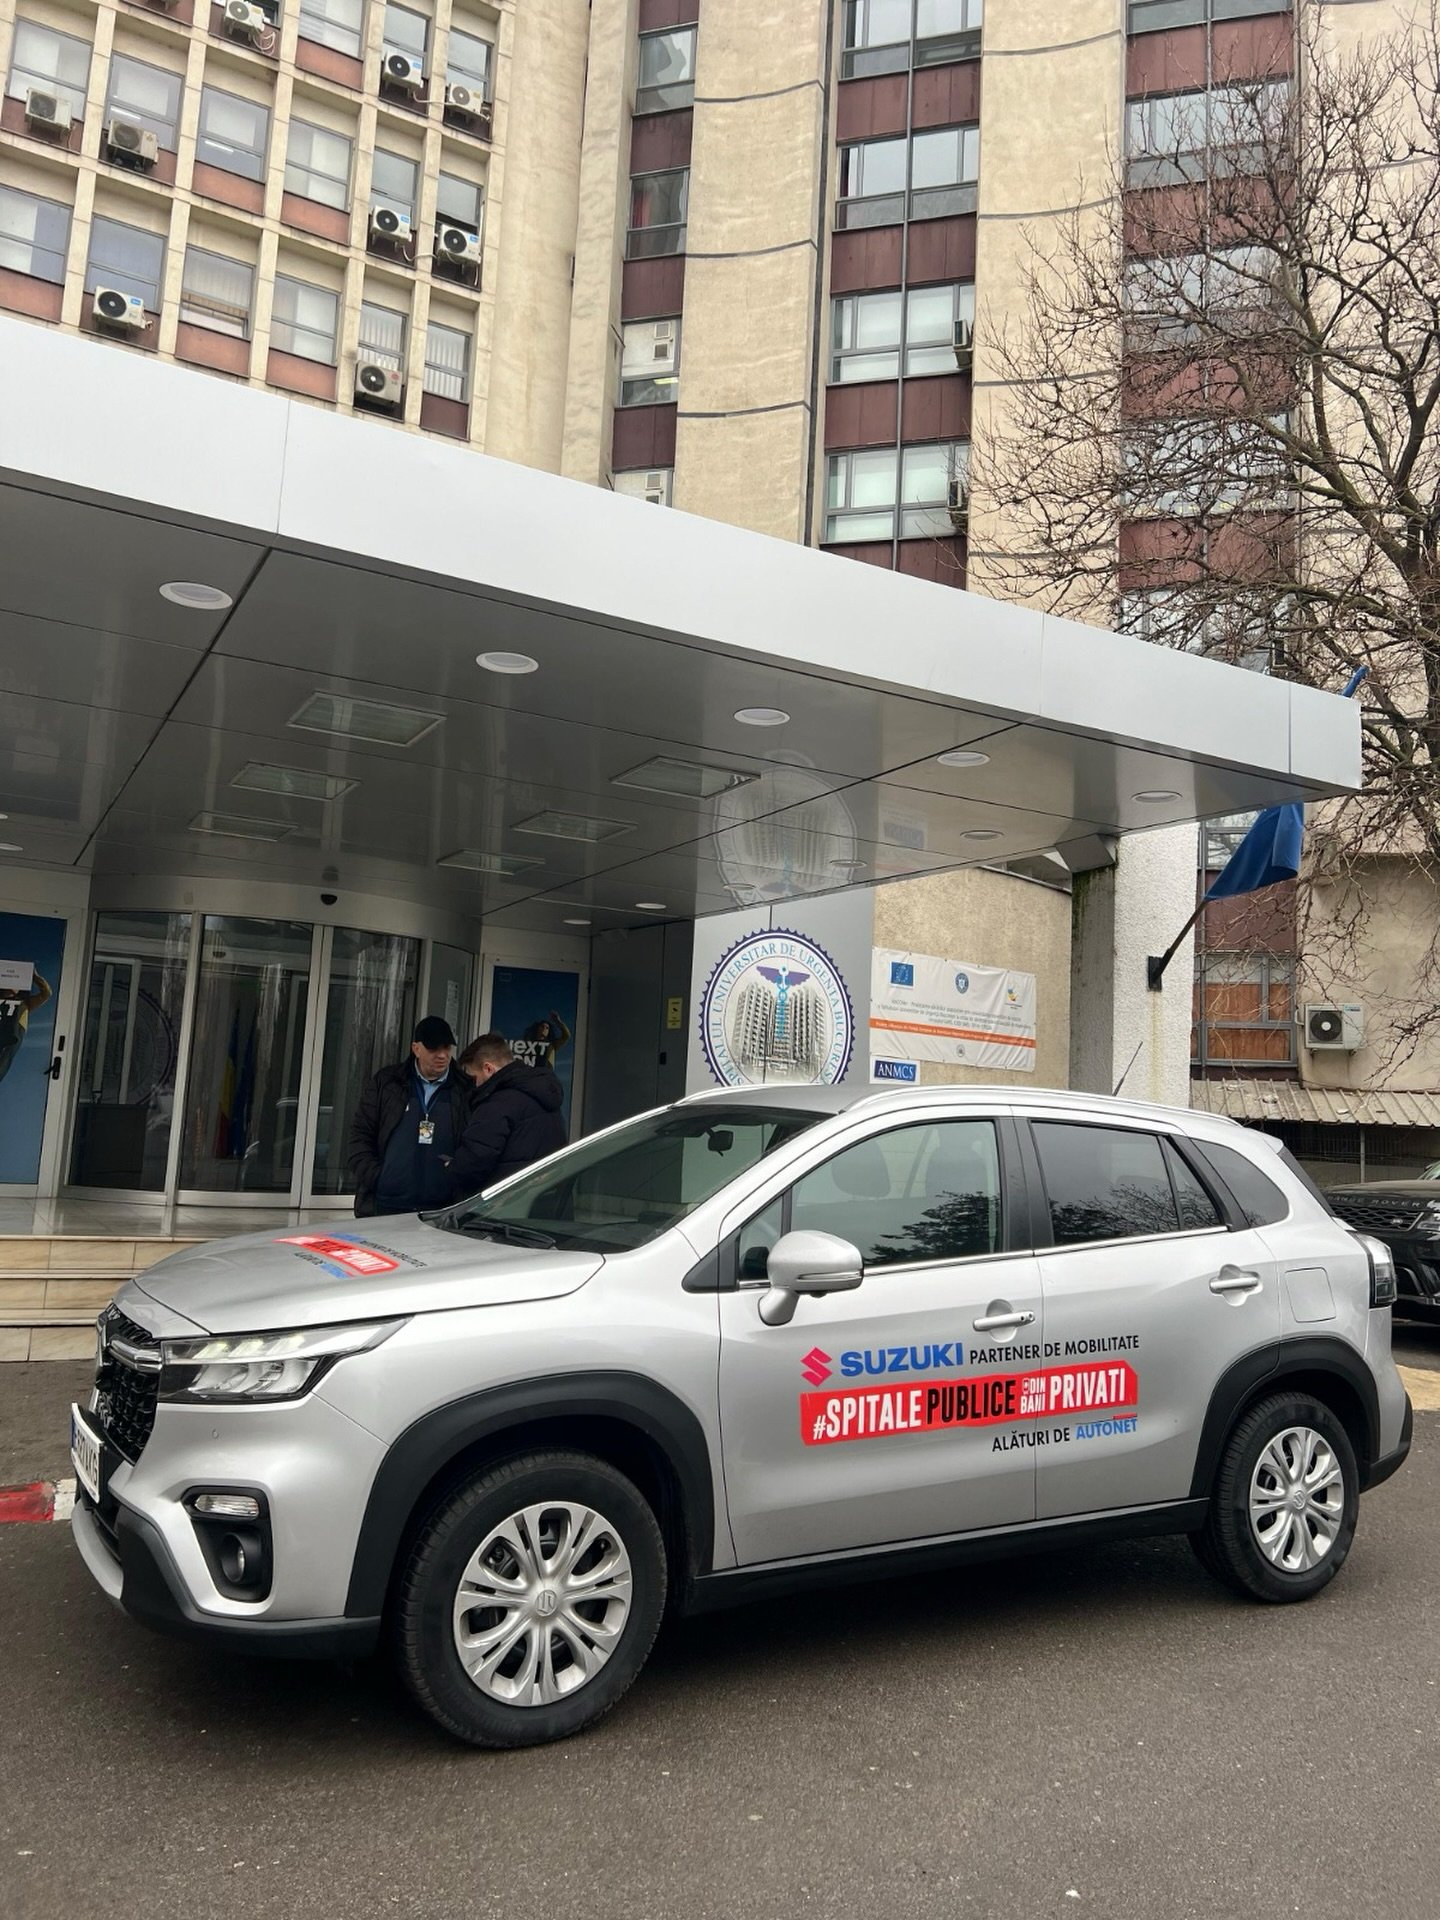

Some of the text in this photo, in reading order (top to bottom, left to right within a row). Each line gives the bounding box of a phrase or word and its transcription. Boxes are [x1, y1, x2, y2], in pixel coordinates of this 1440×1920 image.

[712, 942, 777, 1013] UNIVERSITAR
[780, 942, 796, 957] DE
[877, 1062, 914, 1079] ANMCS
[840, 1335, 1140, 1377] SUZUKI PARTENER DE MOBILITATE
[1020, 1392, 1046, 1414] BANI
[1030, 1376, 1046, 1394] DIN
[1049, 1368, 1126, 1411] PRIVATI
[813, 1380, 1016, 1440] #SPITALE PUBLICE
[992, 1418, 1138, 1452] ALĂTURI DE AUTONET
